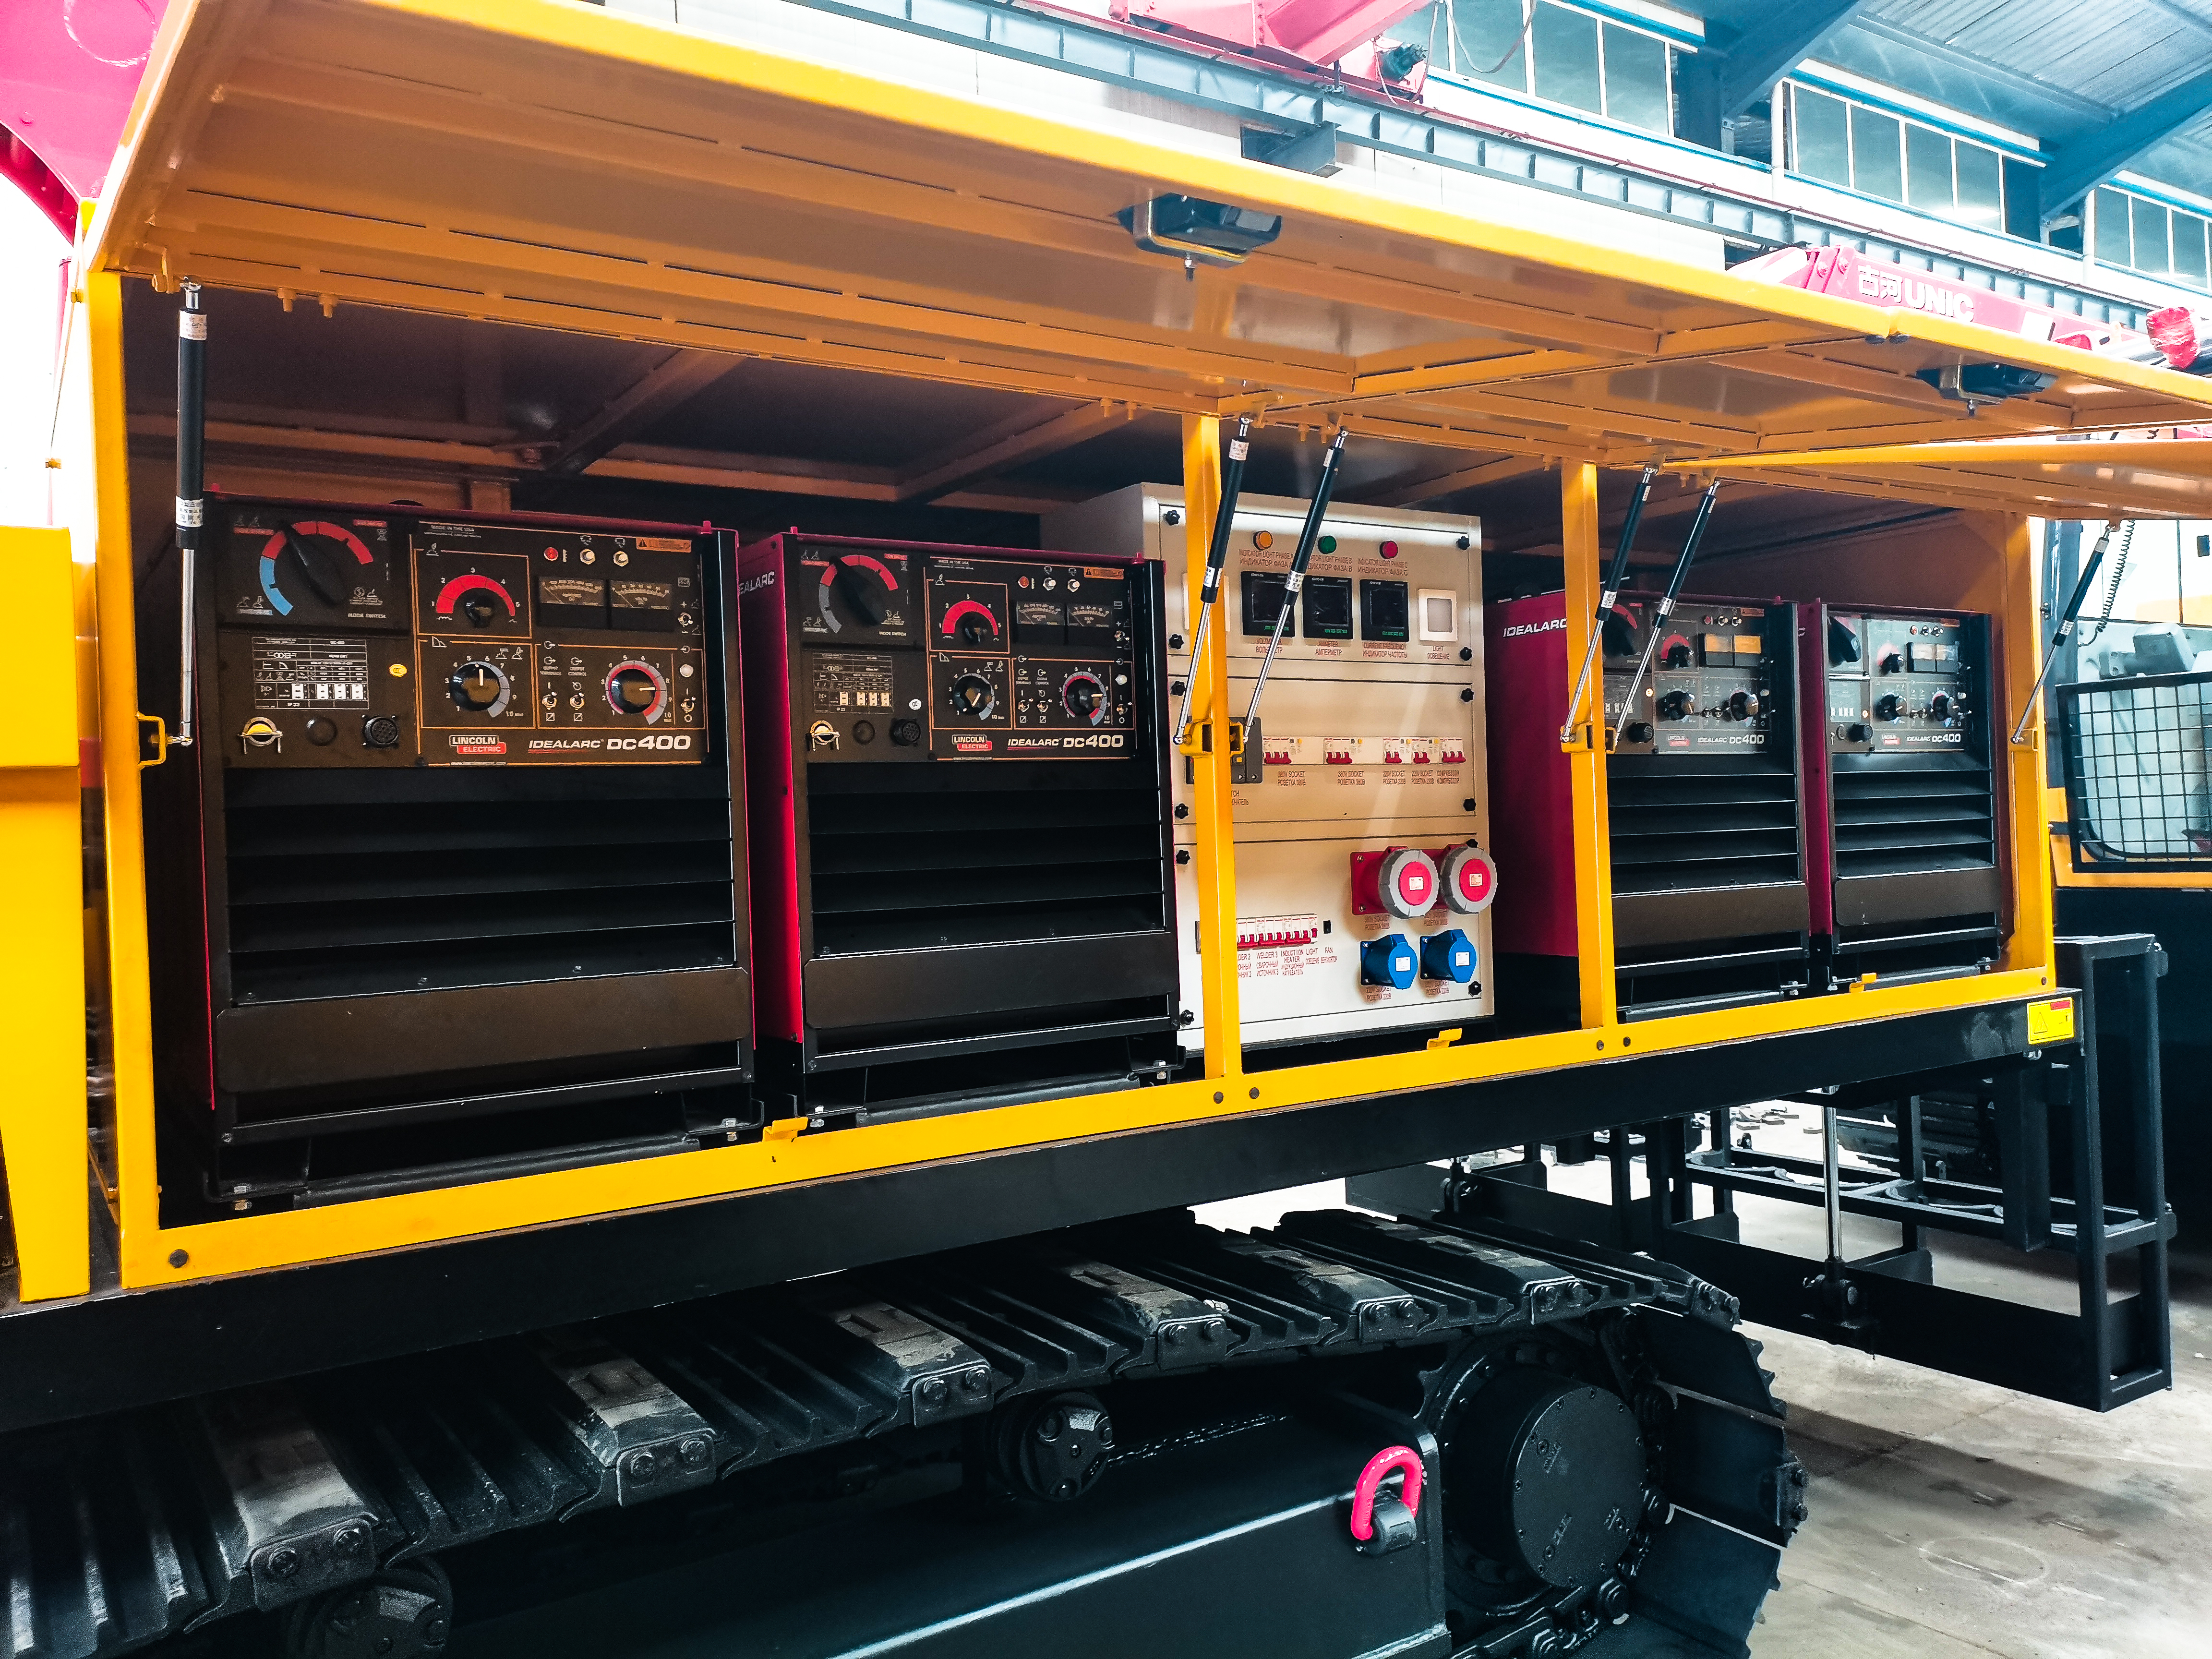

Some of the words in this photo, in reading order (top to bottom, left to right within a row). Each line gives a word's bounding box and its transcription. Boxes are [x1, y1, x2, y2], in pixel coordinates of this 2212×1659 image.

[1857, 264, 1903, 303] 古河
[1904, 277, 1974, 322] UNIC
[1503, 618, 1567, 637] IDEALARC
[529, 740, 601, 748] IDEALARC
[606, 735, 691, 750] DC400
[1063, 734, 1124, 747] DC400
[1729, 734, 1764, 744] DC400
[1932, 733, 1961, 743] DC400
[1256, 951, 1274, 960] WELDER
[1306, 947, 1319, 956] LIGHT
